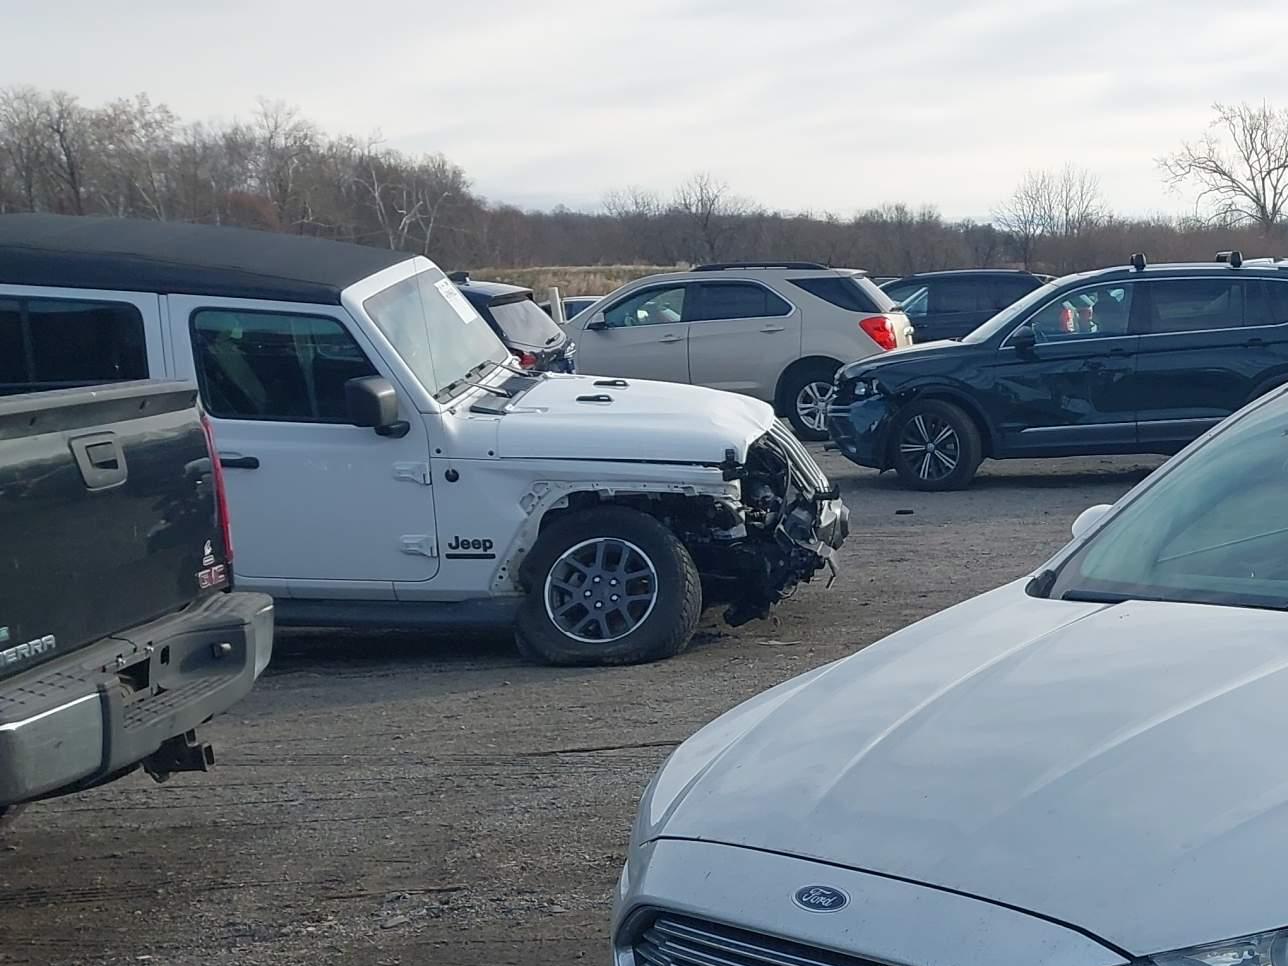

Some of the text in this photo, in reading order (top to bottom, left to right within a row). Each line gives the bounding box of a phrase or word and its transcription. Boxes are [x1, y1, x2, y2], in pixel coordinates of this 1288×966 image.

[447, 535, 494, 553] Jeep
[0, 633, 56, 667] IERRA
[802, 887, 838, 907] Ford
